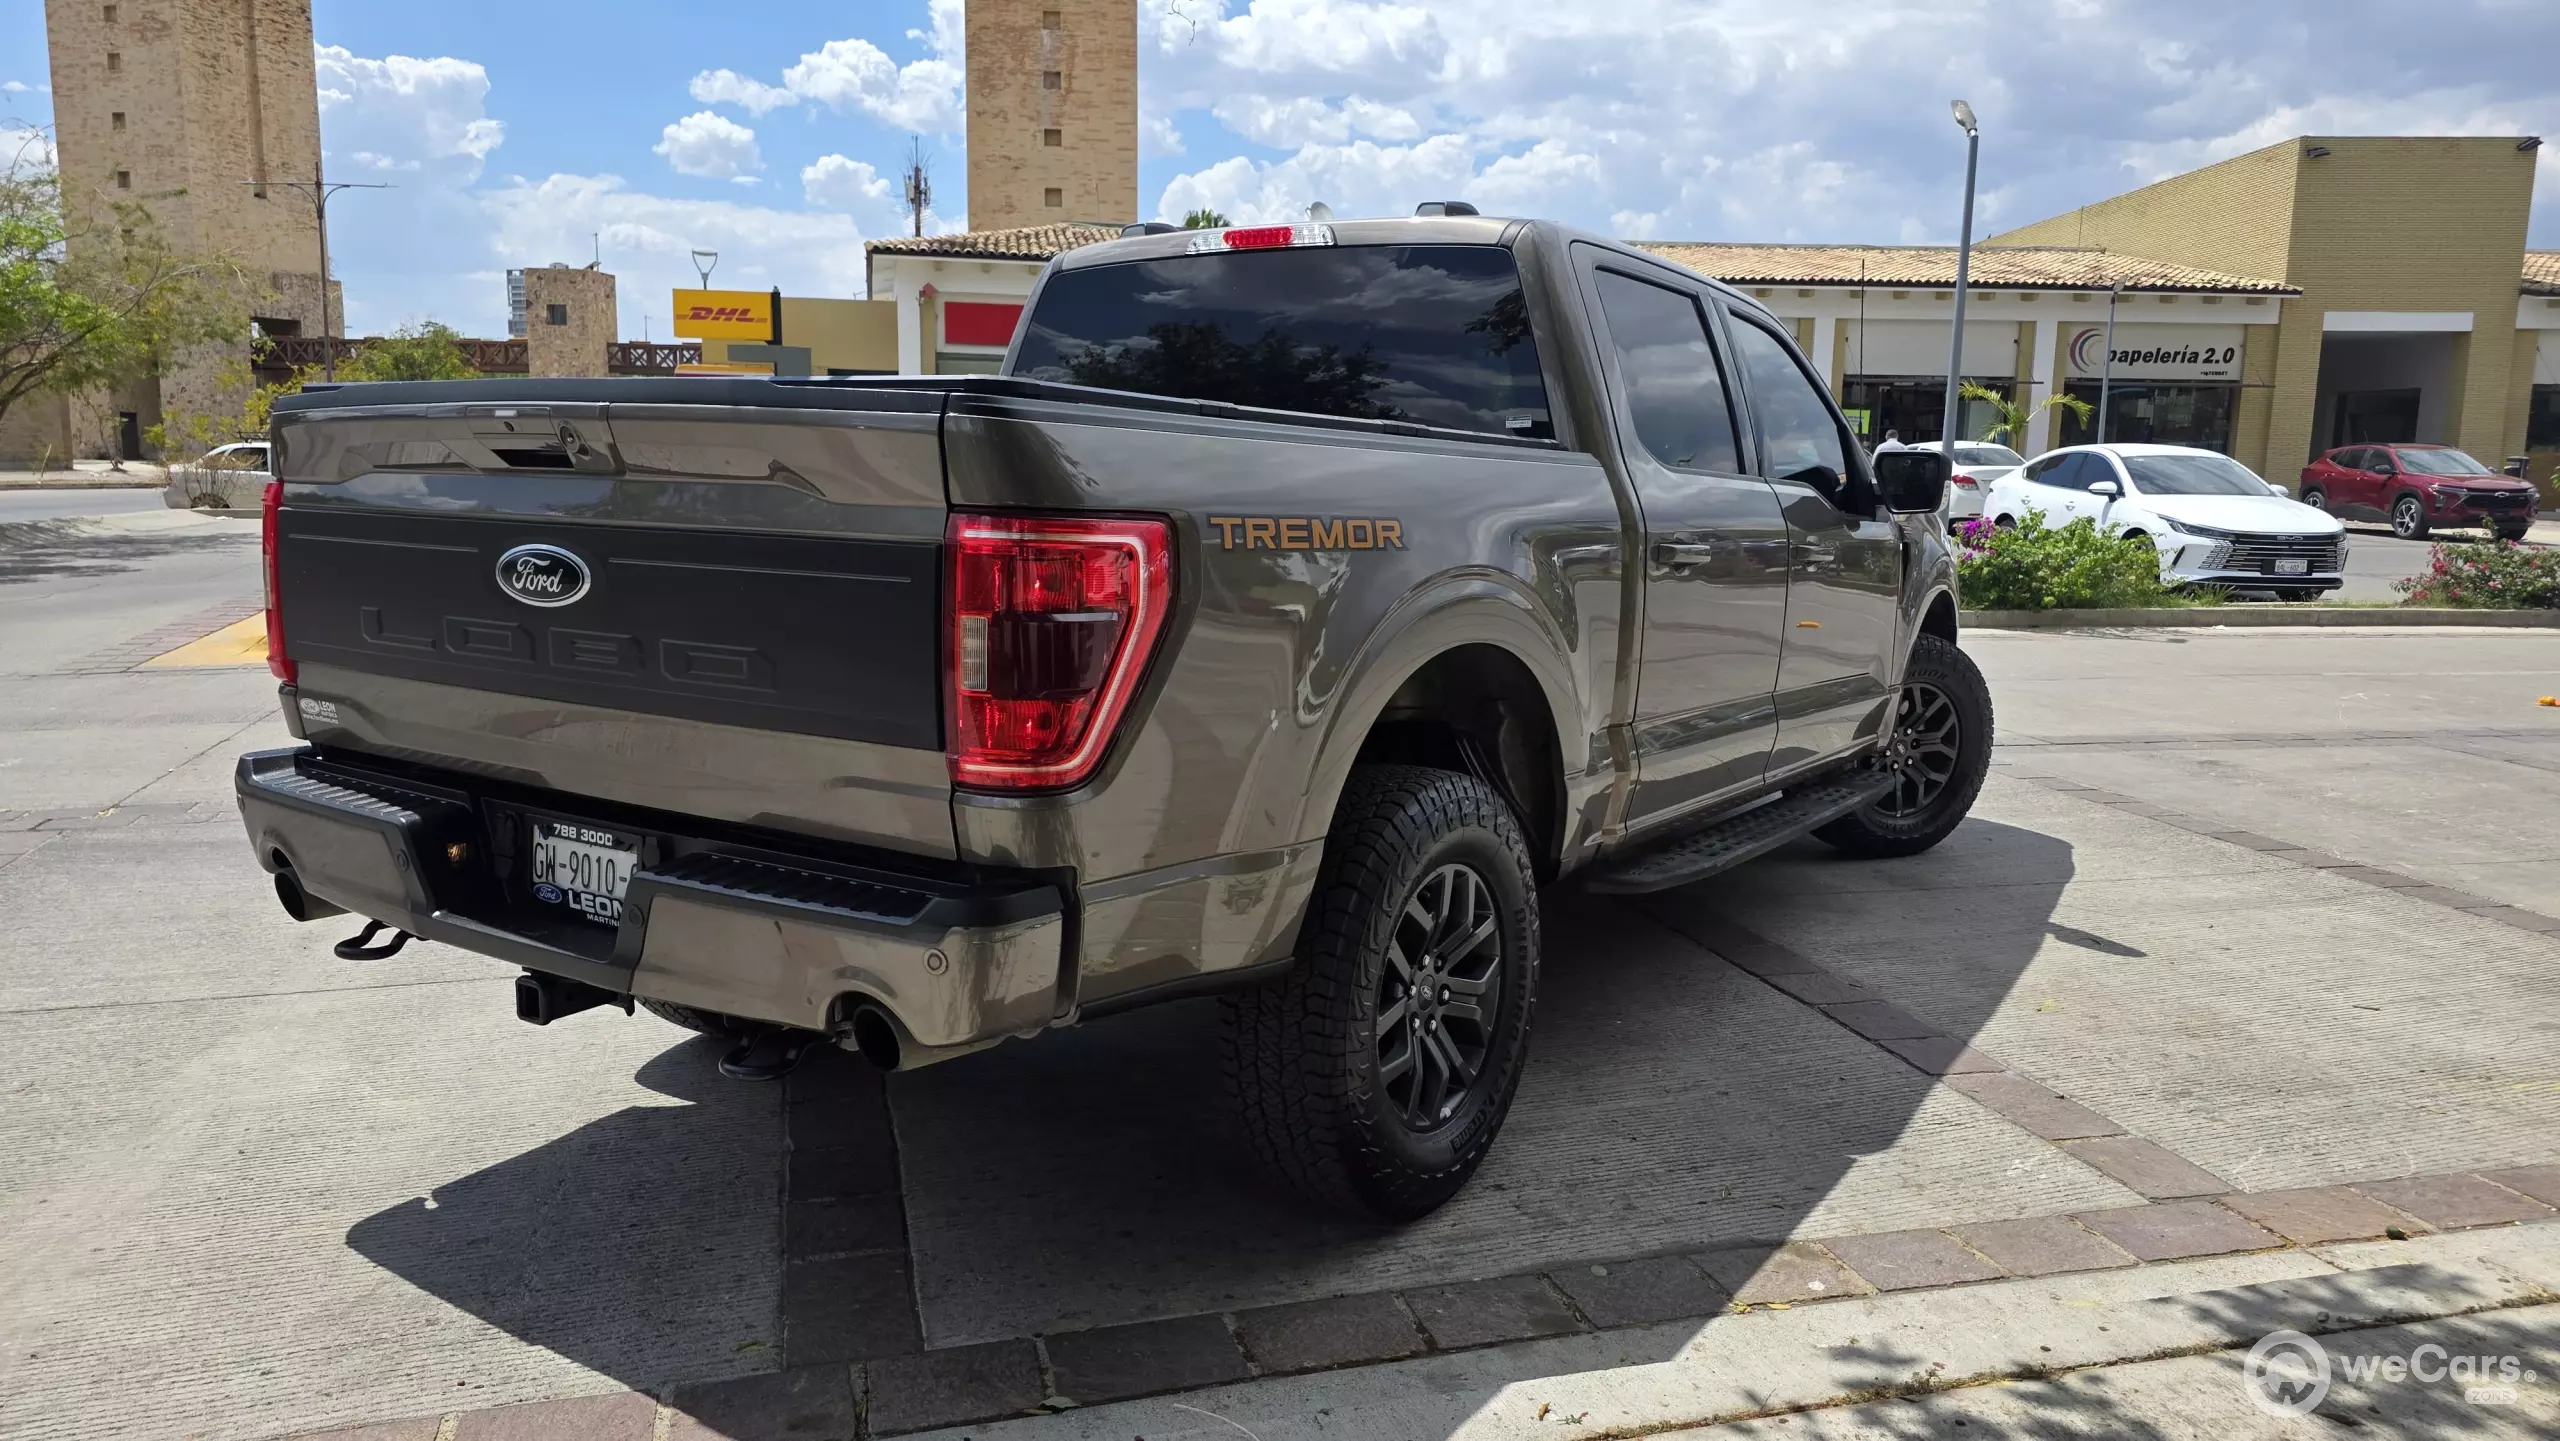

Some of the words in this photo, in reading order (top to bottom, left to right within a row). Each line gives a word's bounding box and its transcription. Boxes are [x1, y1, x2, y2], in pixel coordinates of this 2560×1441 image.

[688, 306, 756, 323] DHL
[2202, 347, 2235, 364] 2.0
[1207, 515, 1405, 550] TREMOR
[512, 556, 563, 594] Ford
[361, 606, 779, 693] LOBO
[553, 823, 577, 839] 788
[580, 829, 613, 846] 3000
